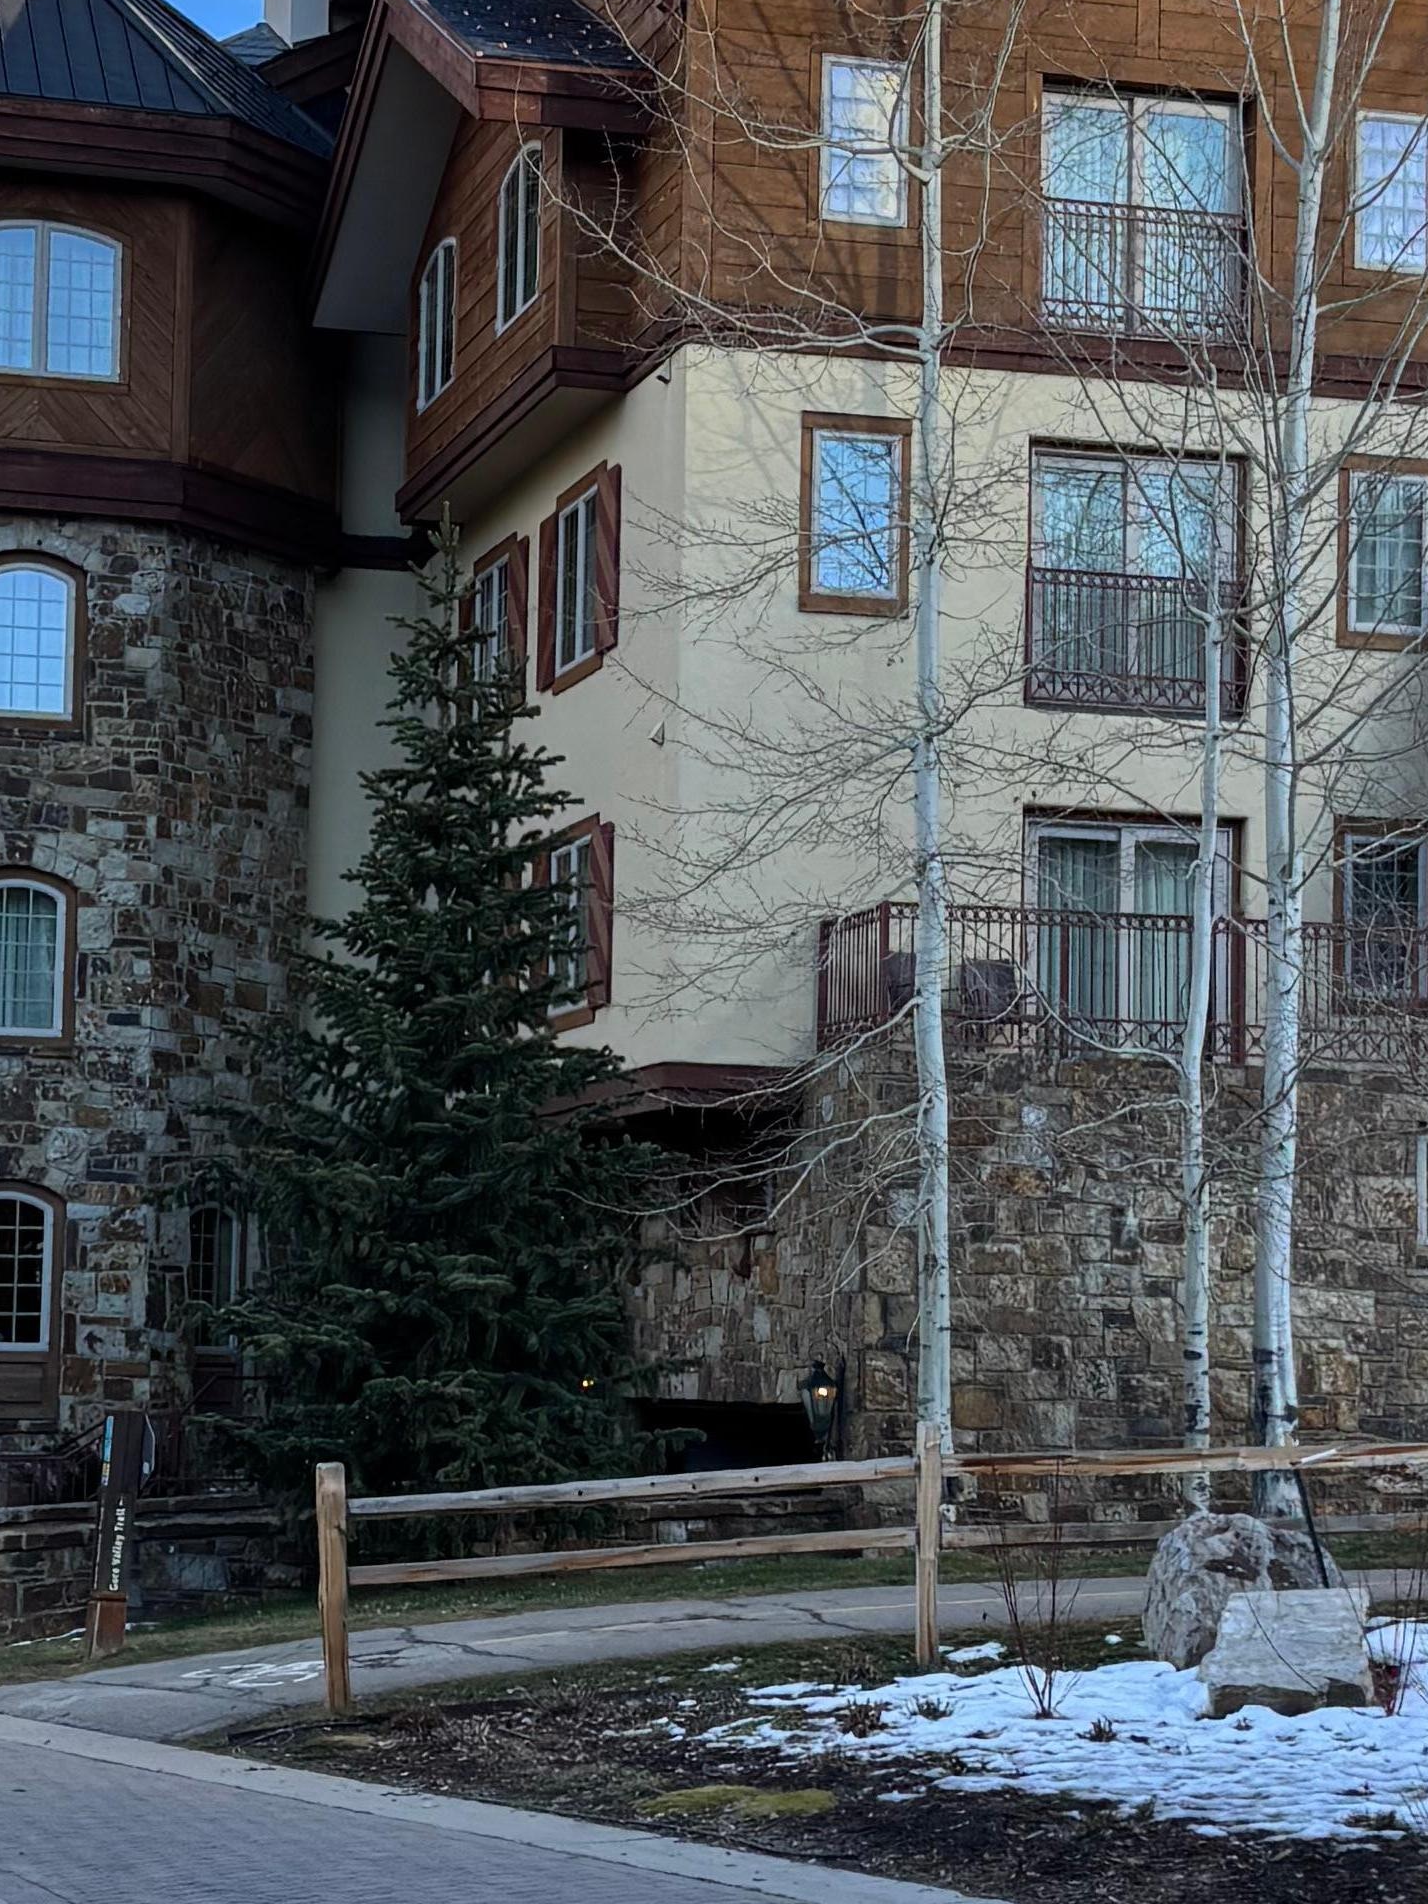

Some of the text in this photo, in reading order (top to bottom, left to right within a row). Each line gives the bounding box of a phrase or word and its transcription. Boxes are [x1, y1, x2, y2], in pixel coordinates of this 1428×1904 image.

[109, 1508, 126, 1591] Gore Valley Trail
